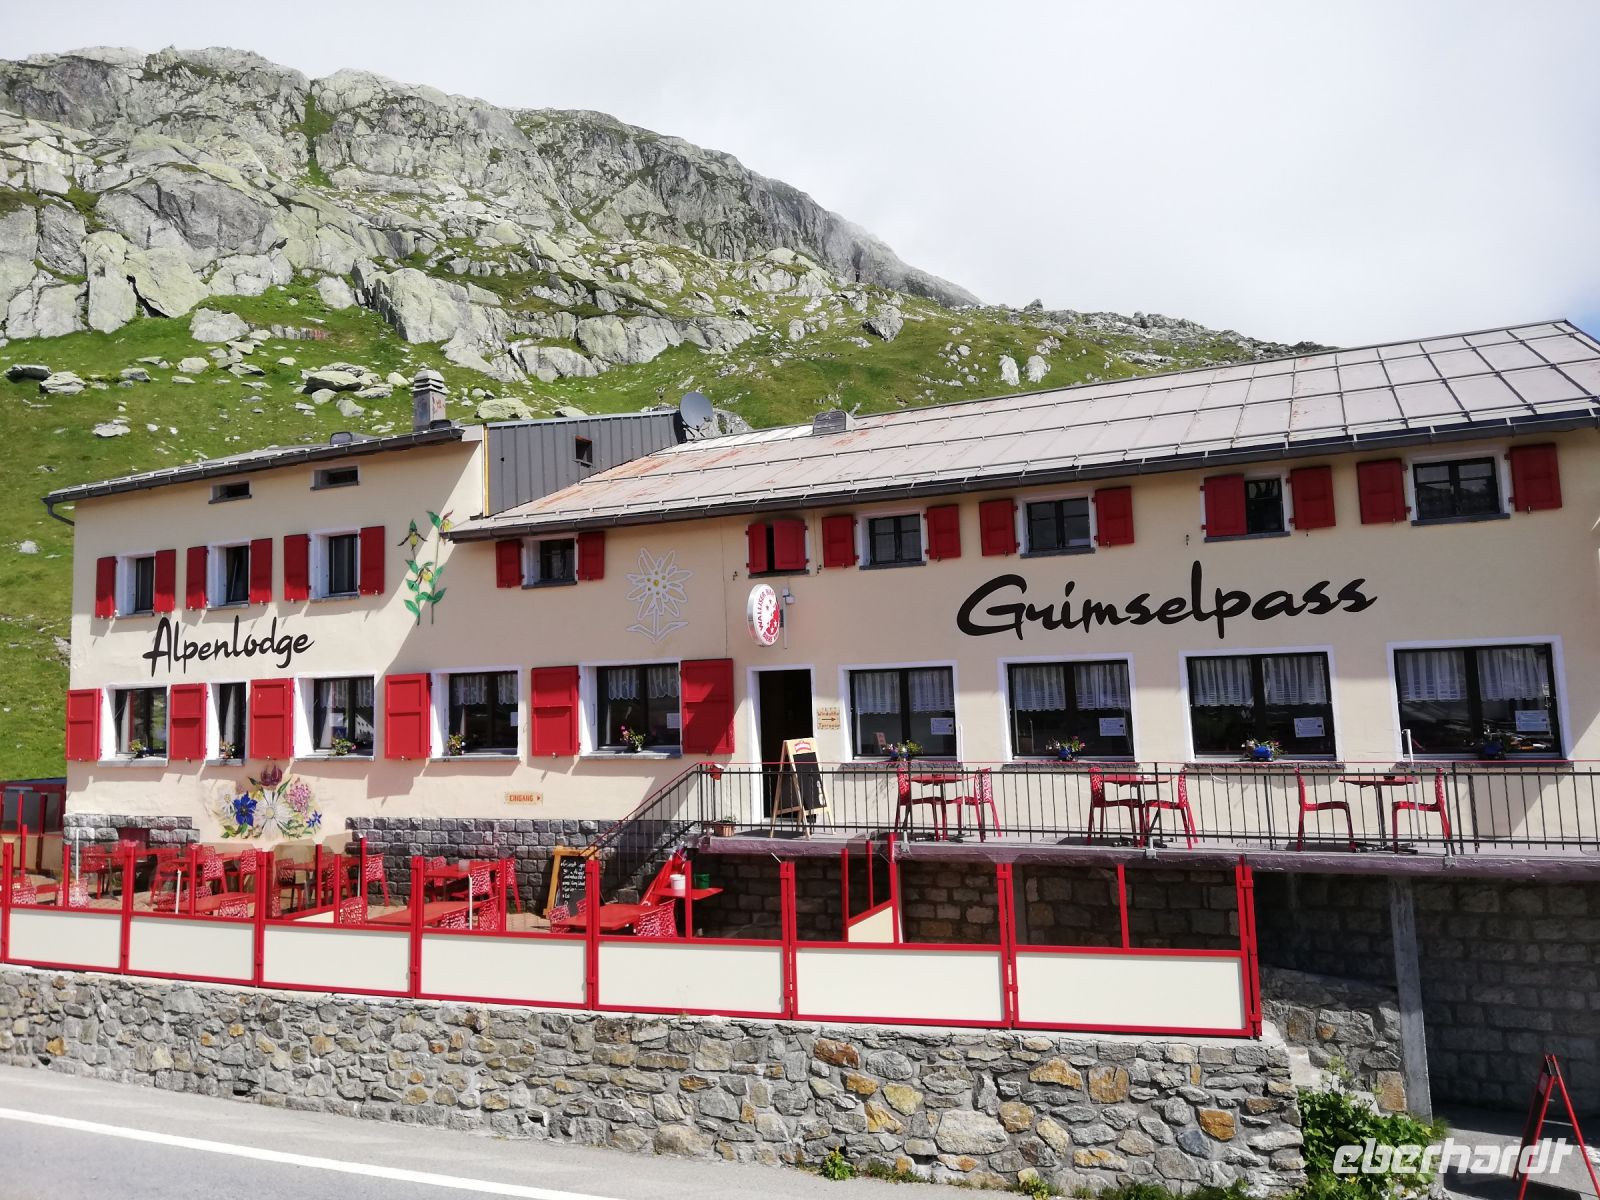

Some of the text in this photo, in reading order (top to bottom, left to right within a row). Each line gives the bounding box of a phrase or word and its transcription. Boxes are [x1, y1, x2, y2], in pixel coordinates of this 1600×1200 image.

[957, 559, 1378, 641] Grimselpass
[143, 615, 315, 678] Alpenlodge
[509, 794, 534, 802] EINGANG
